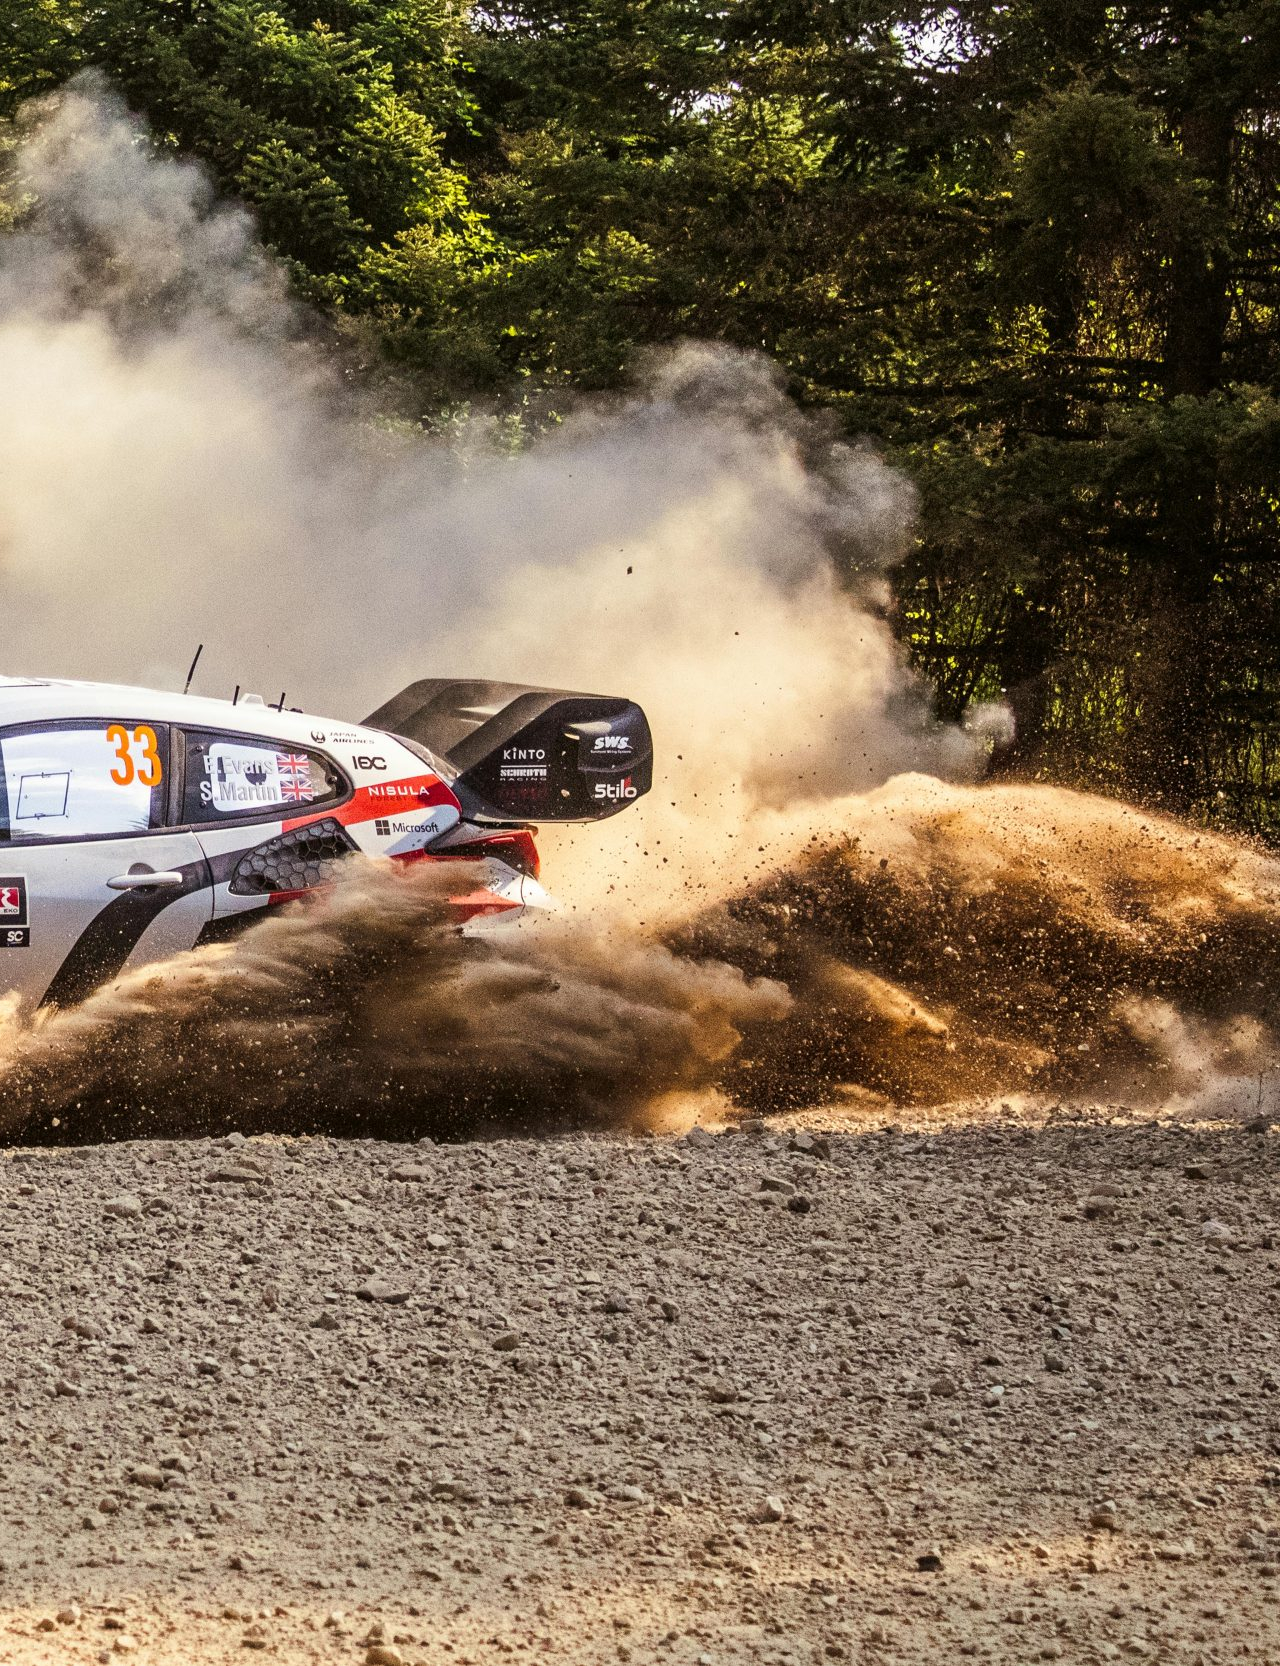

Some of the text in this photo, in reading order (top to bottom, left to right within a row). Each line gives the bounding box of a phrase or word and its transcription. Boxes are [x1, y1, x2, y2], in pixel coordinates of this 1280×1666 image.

[593, 736, 632, 750] SWS
[106, 724, 163, 787] 33
[367, 785, 431, 797] NISULA
[594, 779, 638, 799] Stilo
[392, 821, 440, 834] Microsoft
[6, 930, 24, 943] SC
